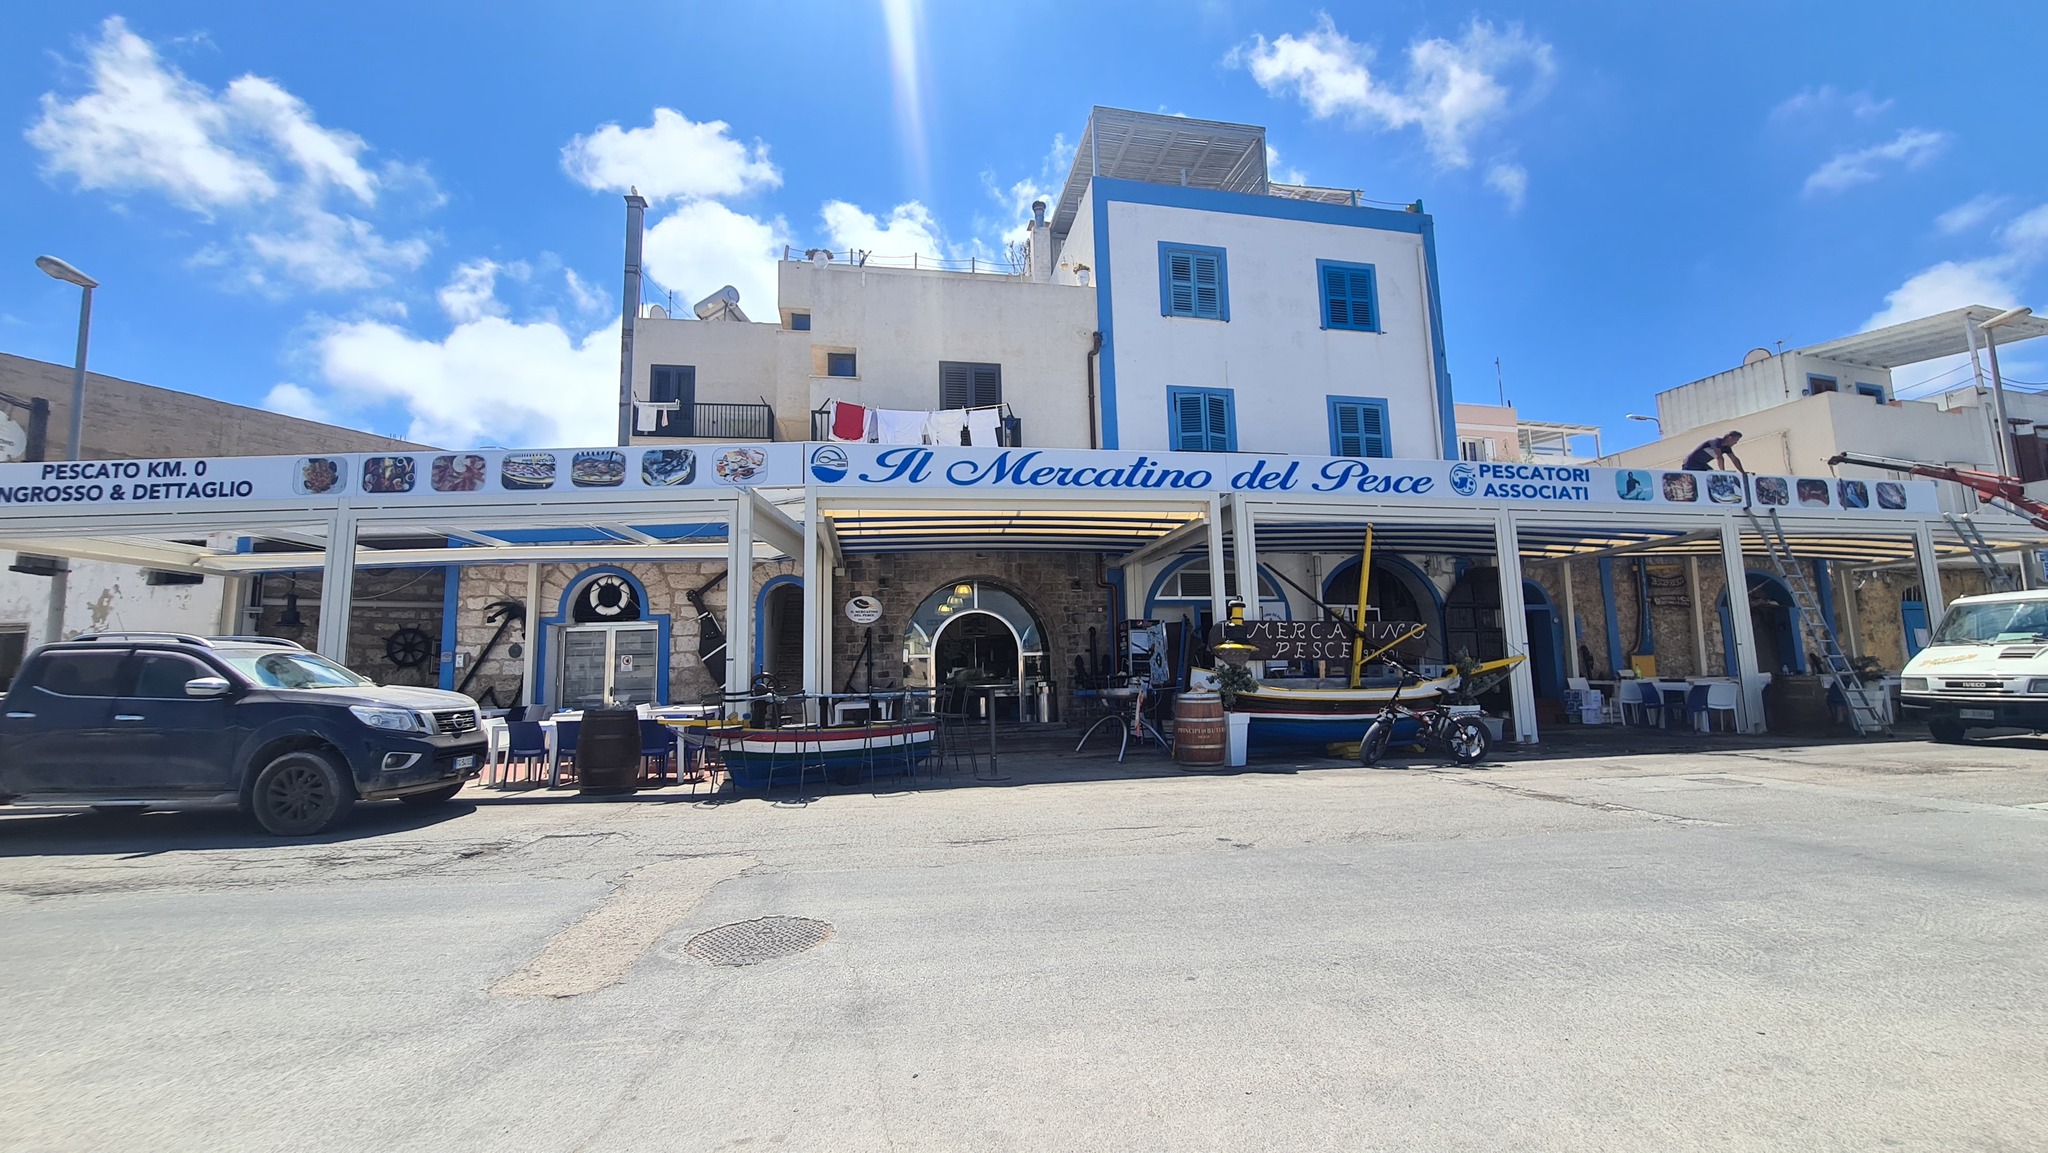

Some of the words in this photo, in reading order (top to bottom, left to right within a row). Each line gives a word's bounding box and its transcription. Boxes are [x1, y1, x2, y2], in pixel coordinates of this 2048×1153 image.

[41, 462, 141, 480] PESCATO
[147, 461, 187, 478] KM.
[858, 447, 934, 484] Il
[946, 450, 1212, 489] Mercatino
[1231, 459, 1300, 491] del
[1311, 459, 1435, 495] Pesce
[1479, 463, 1590, 483] PESCATORI
[109, 484, 126, 501] &
[132, 480, 253, 500] DETTAGLIO
[1483, 483, 1589, 501] ASSOCIATI
[1246, 621, 1425, 640] MERCAINO
[1272, 641, 1352, 659] PESCE
